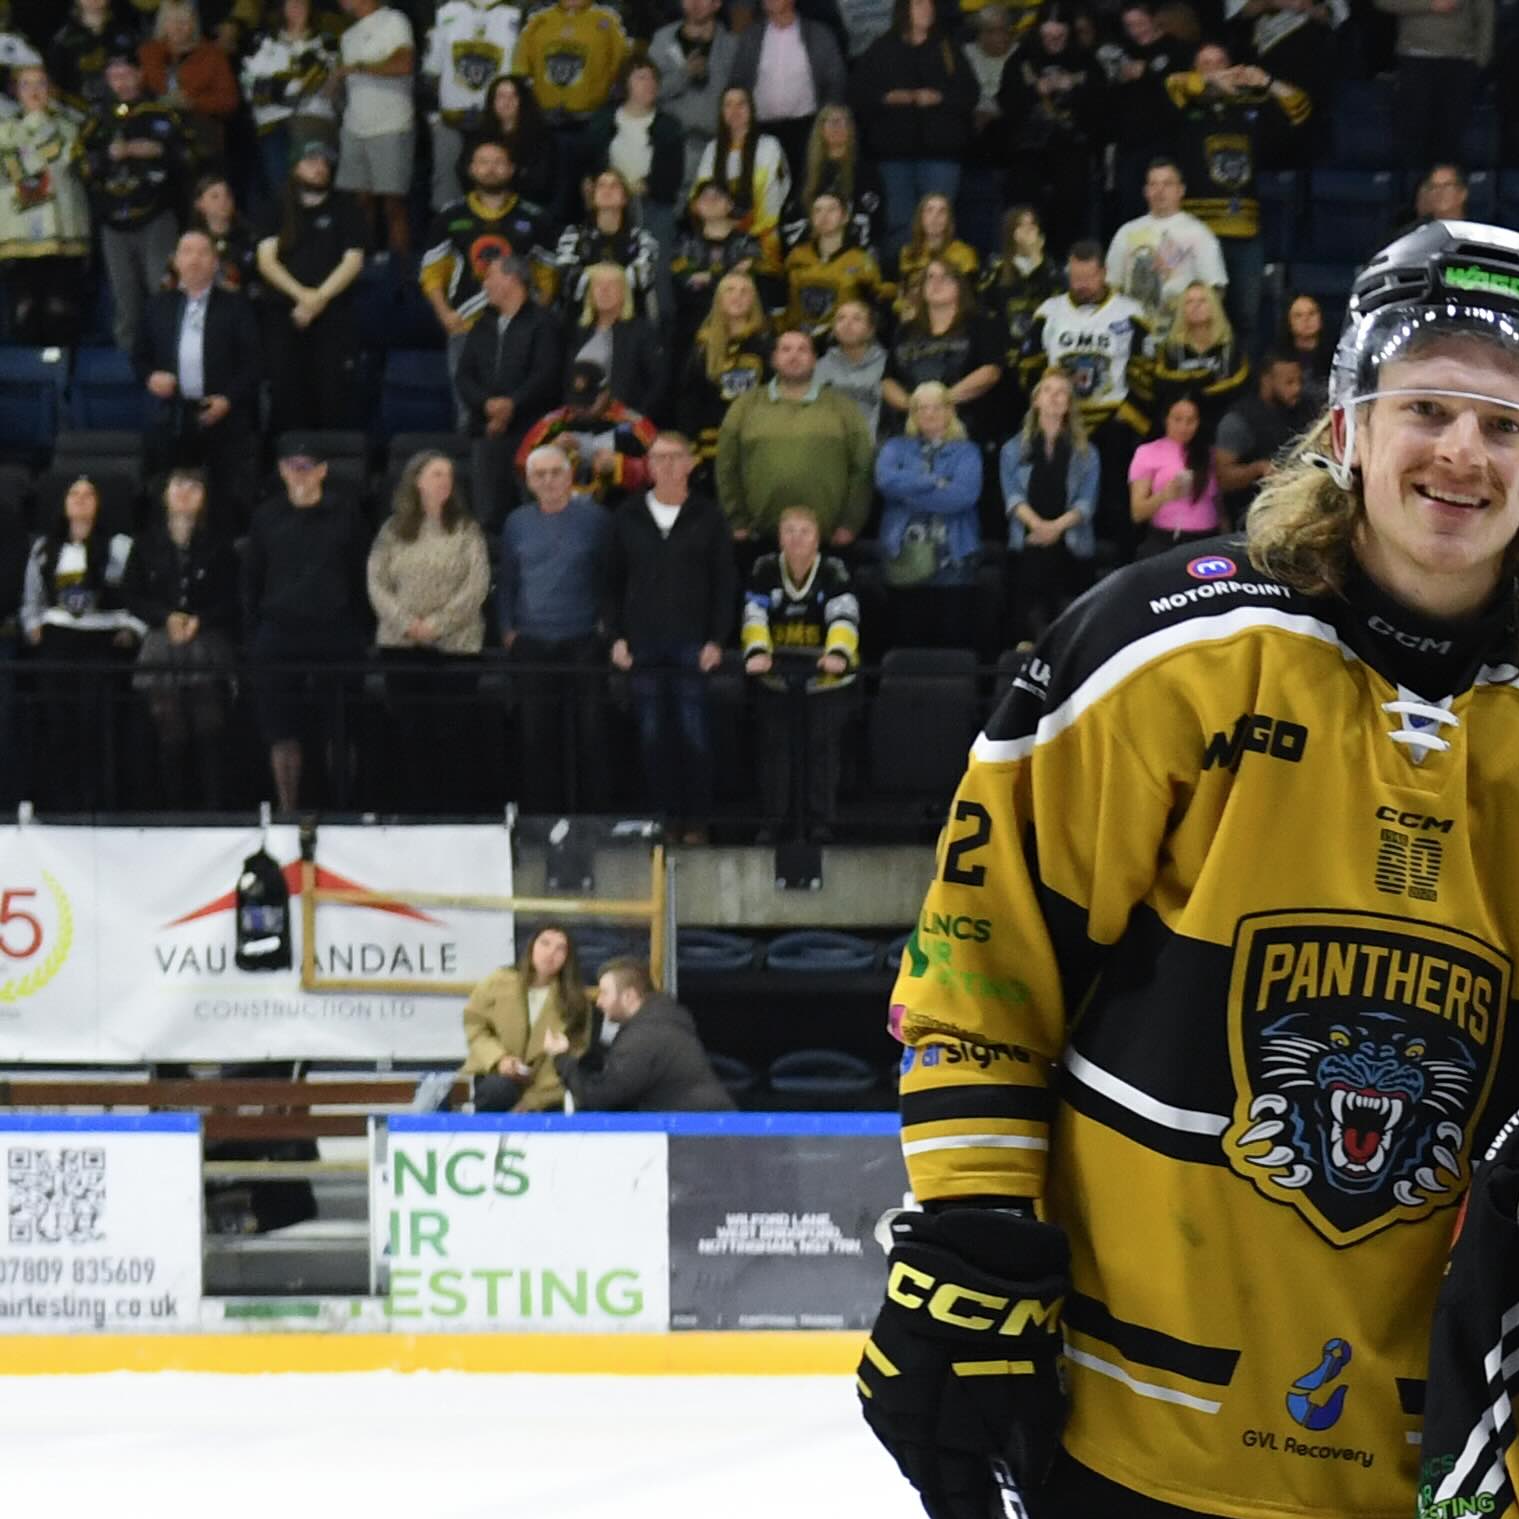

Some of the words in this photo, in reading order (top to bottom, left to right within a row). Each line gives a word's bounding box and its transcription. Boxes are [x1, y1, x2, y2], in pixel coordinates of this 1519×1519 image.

[1149, 580, 1290, 615] MOTORPOINT
[1367, 615, 1452, 655] CCM
[1375, 805, 1456, 834] CCM
[154, 942, 458, 975] VAUANDALE
[194, 999, 373, 1020] CONSTRUCTION
[380, 999, 416, 1020] LTD
[1256, 937, 1492, 1049] PANTHERS
[394, 1148, 530, 1197] NCS
[389, 1209, 450, 1257] IR
[72, 1255, 156, 1285] 835609
[350, 1268, 644, 1318] ESTING
[887, 1260, 1064, 1336] CCM
[1241, 1429, 1279, 1451] GVL
[1283, 1436, 1374, 1469] Recovery
